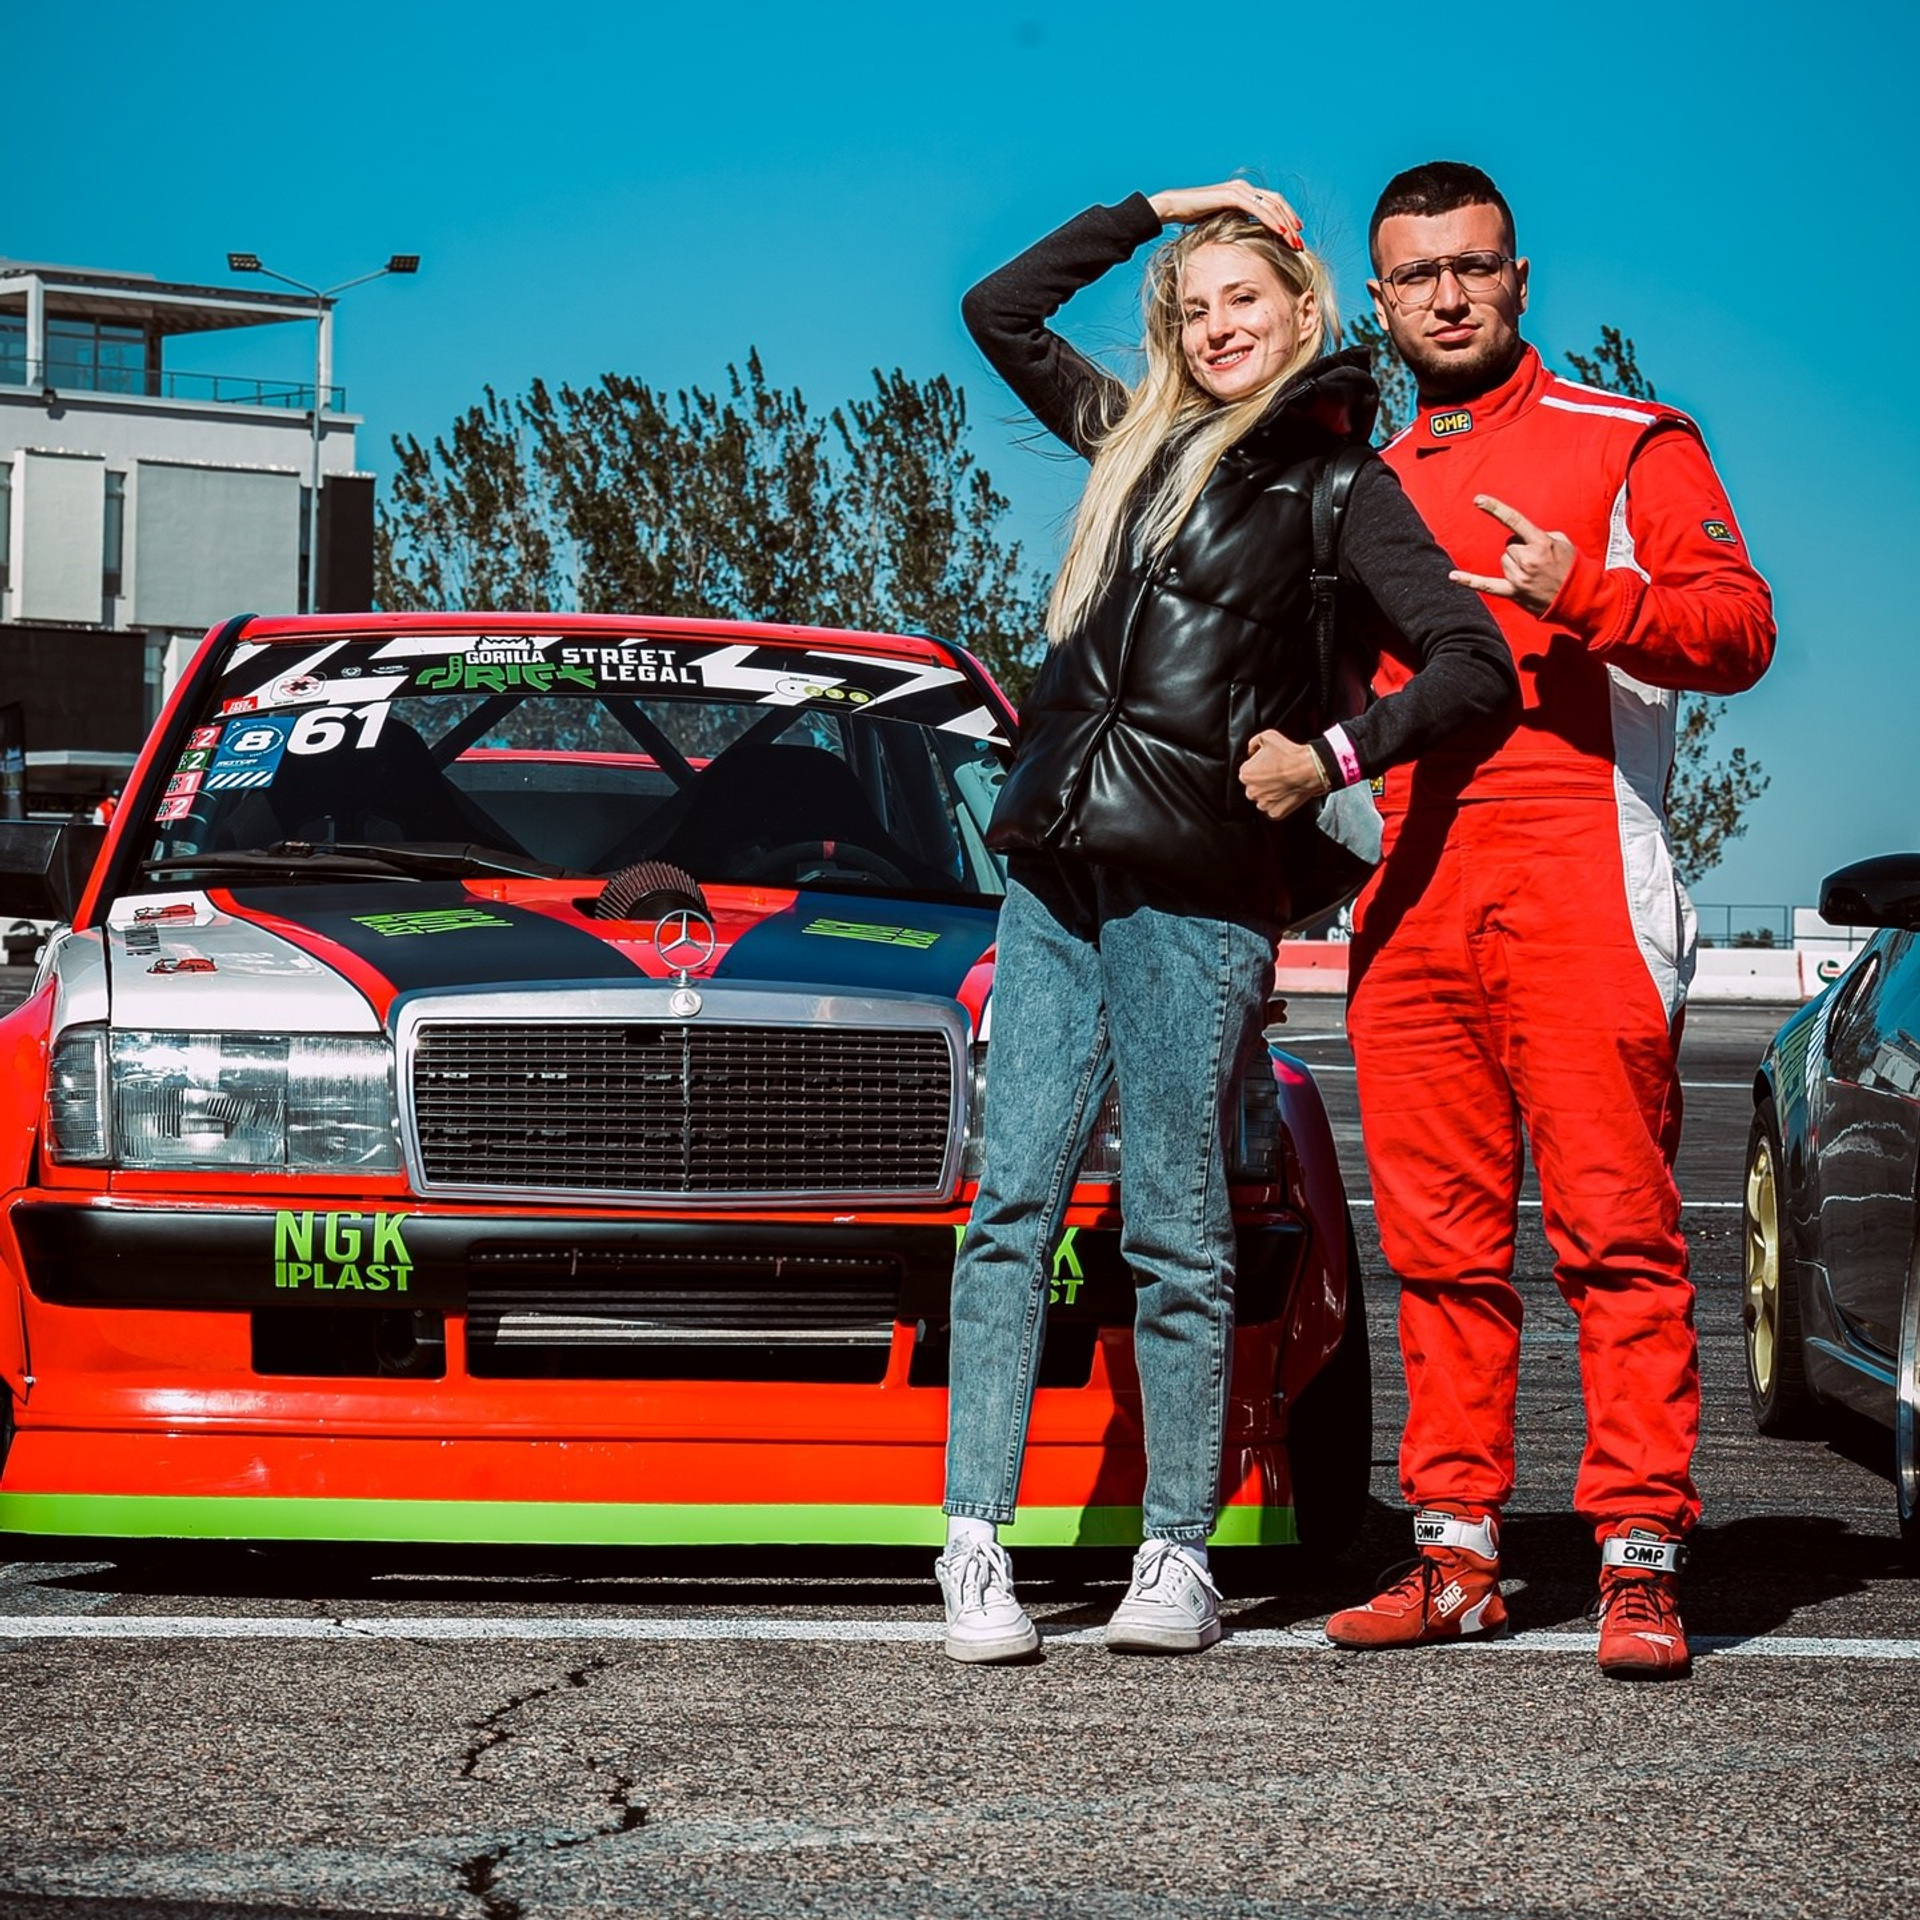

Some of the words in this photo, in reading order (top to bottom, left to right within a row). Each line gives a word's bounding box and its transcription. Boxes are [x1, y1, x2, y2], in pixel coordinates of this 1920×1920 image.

[1434, 413, 1468, 432] OMP
[465, 650, 546, 665] GORILLA
[562, 648, 676, 666] STREET
[600, 664, 697, 684] LEGAL
[287, 701, 392, 755] 61
[197, 729, 216, 747] 2
[233, 730, 275, 752] 8
[187, 751, 206, 770] 2
[183, 774, 197, 793] 1
[169, 798, 188, 817] 2
[274, 1210, 412, 1263] NGK
[274, 1261, 414, 1291] IPLAST
[1416, 1525, 1444, 1540] OMP
[1624, 1546, 1664, 1563] OMP
[1437, 1585, 1464, 1613] OMP
